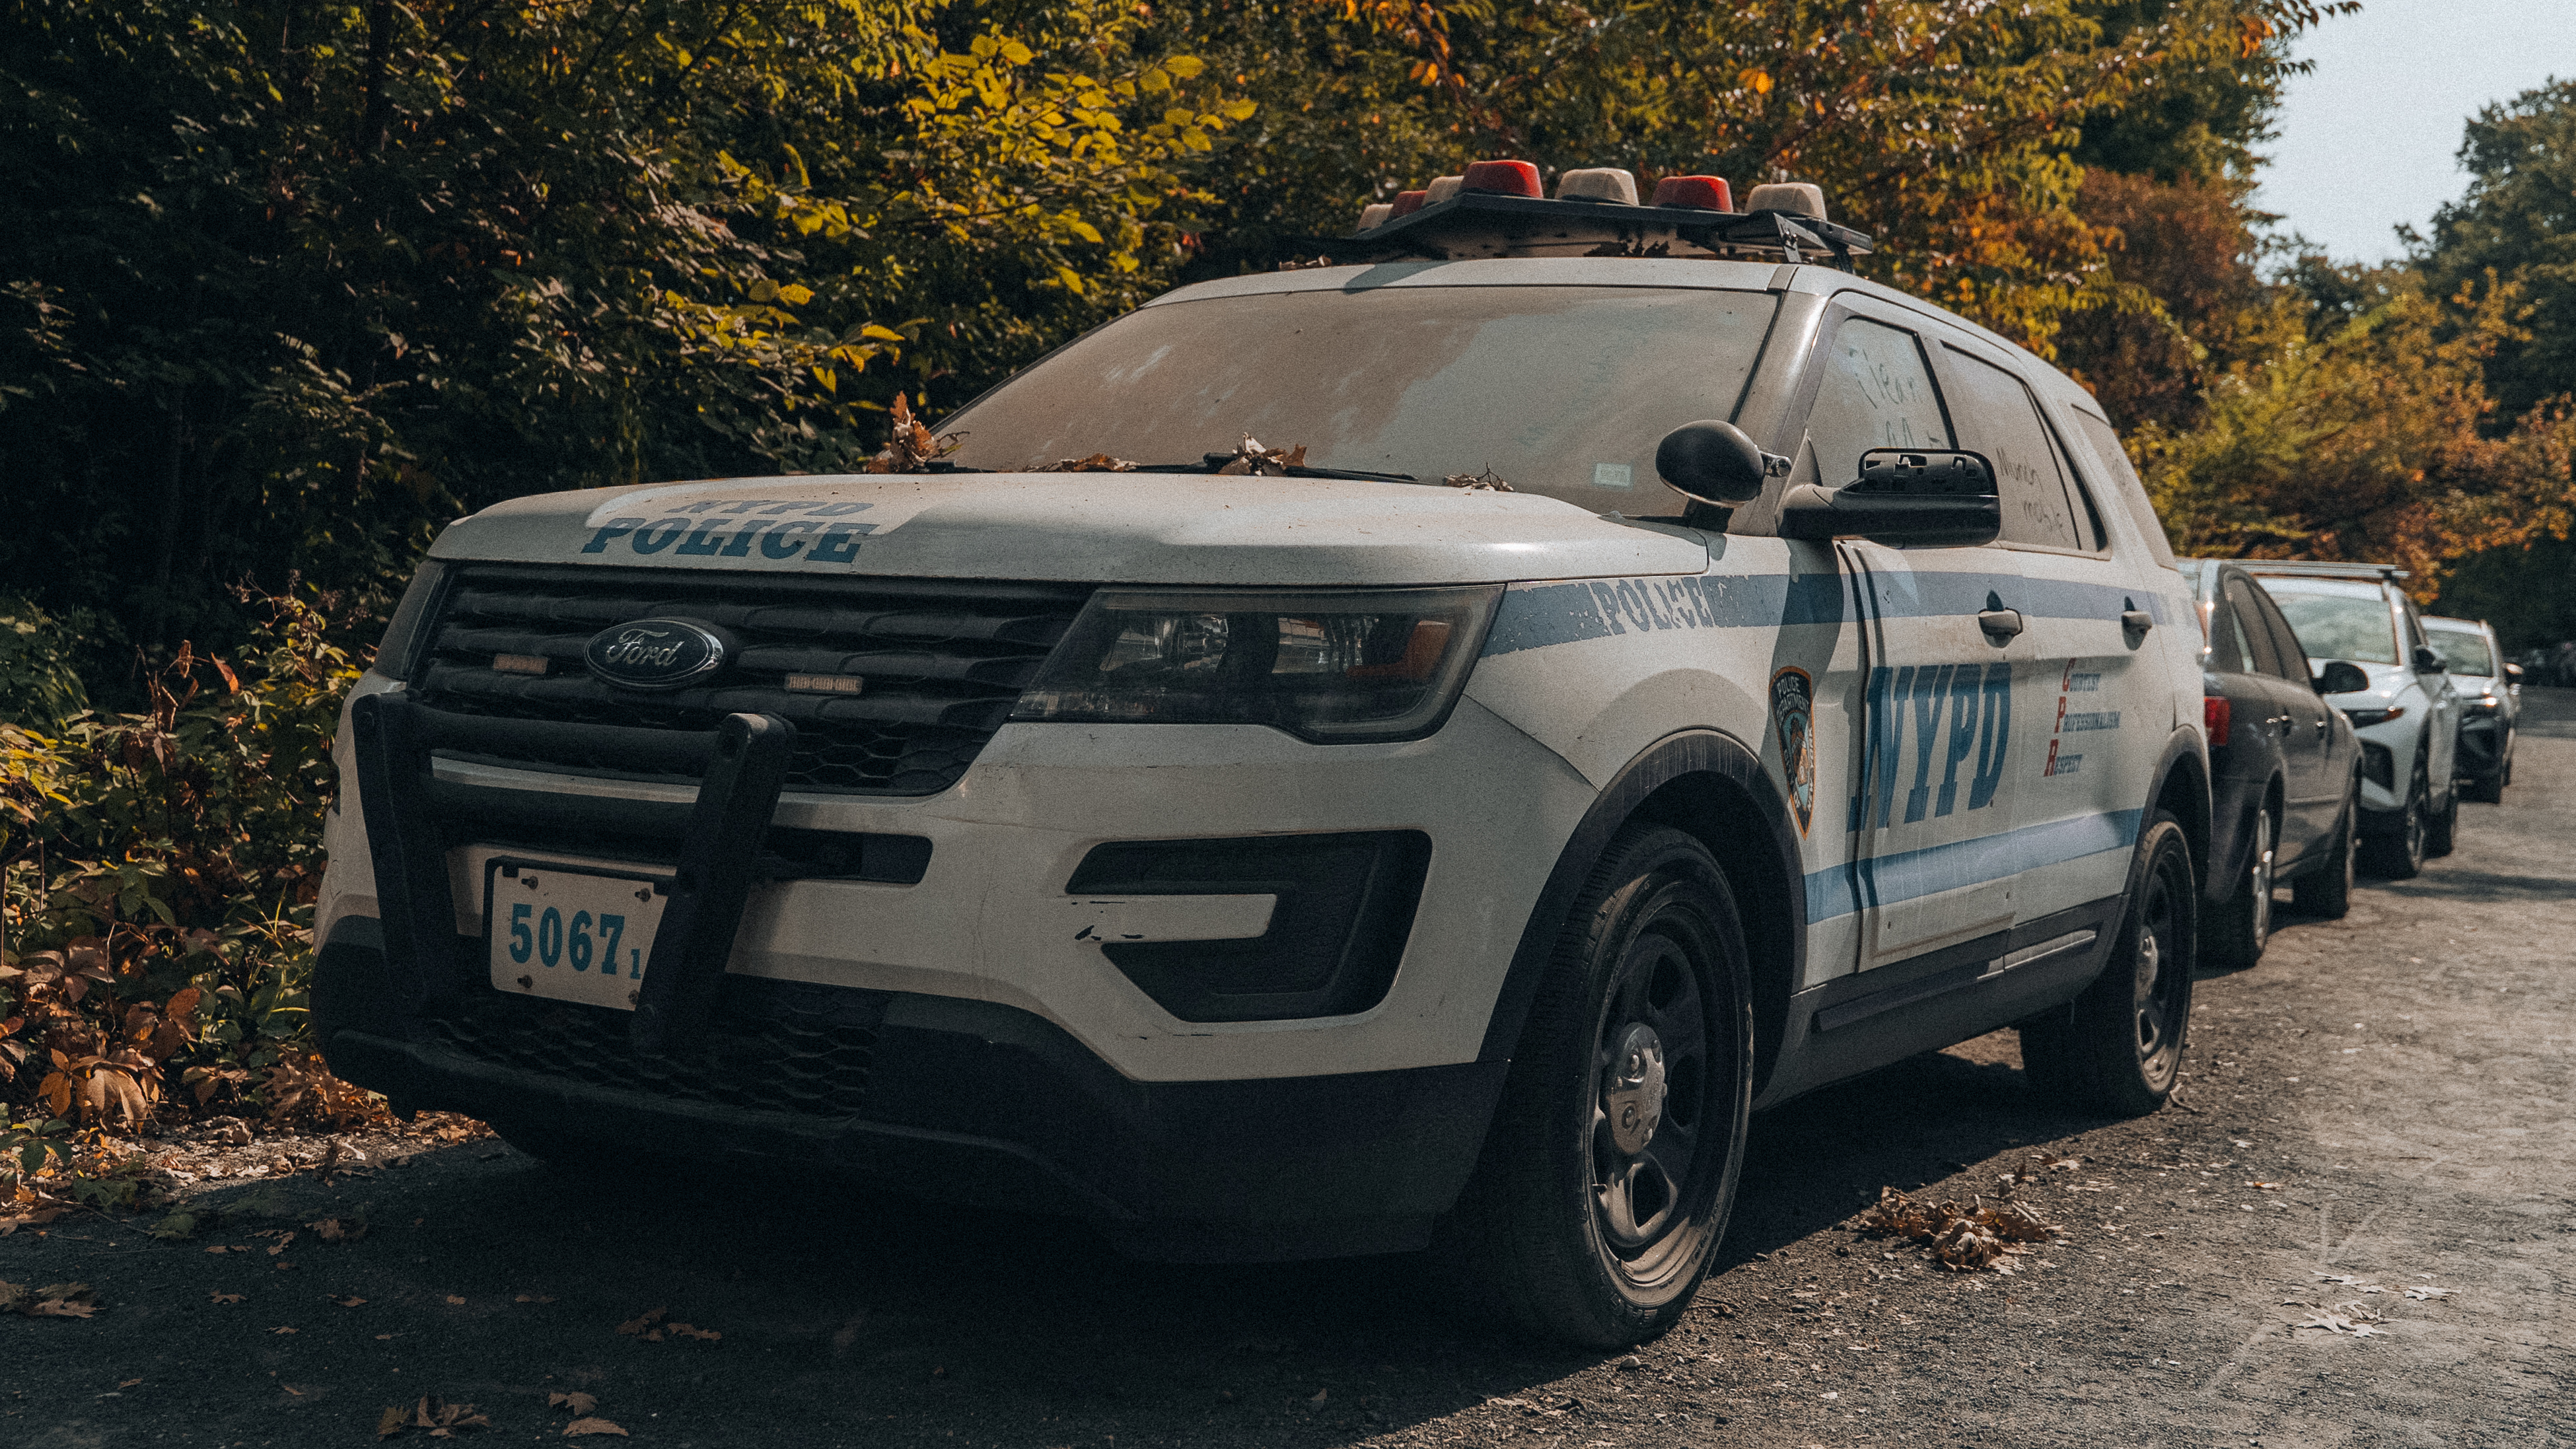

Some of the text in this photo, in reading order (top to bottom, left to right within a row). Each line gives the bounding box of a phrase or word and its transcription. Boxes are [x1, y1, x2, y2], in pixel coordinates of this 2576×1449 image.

[666, 500, 875, 517] NYPD
[581, 517, 882, 563] POLICE
[1590, 577, 1713, 632] POLICE
[605, 628, 685, 668] Ford
[1777, 676, 1801, 699] POLICE
[1846, 662, 2012, 833] NYPD
[509, 903, 625, 975] 5067
